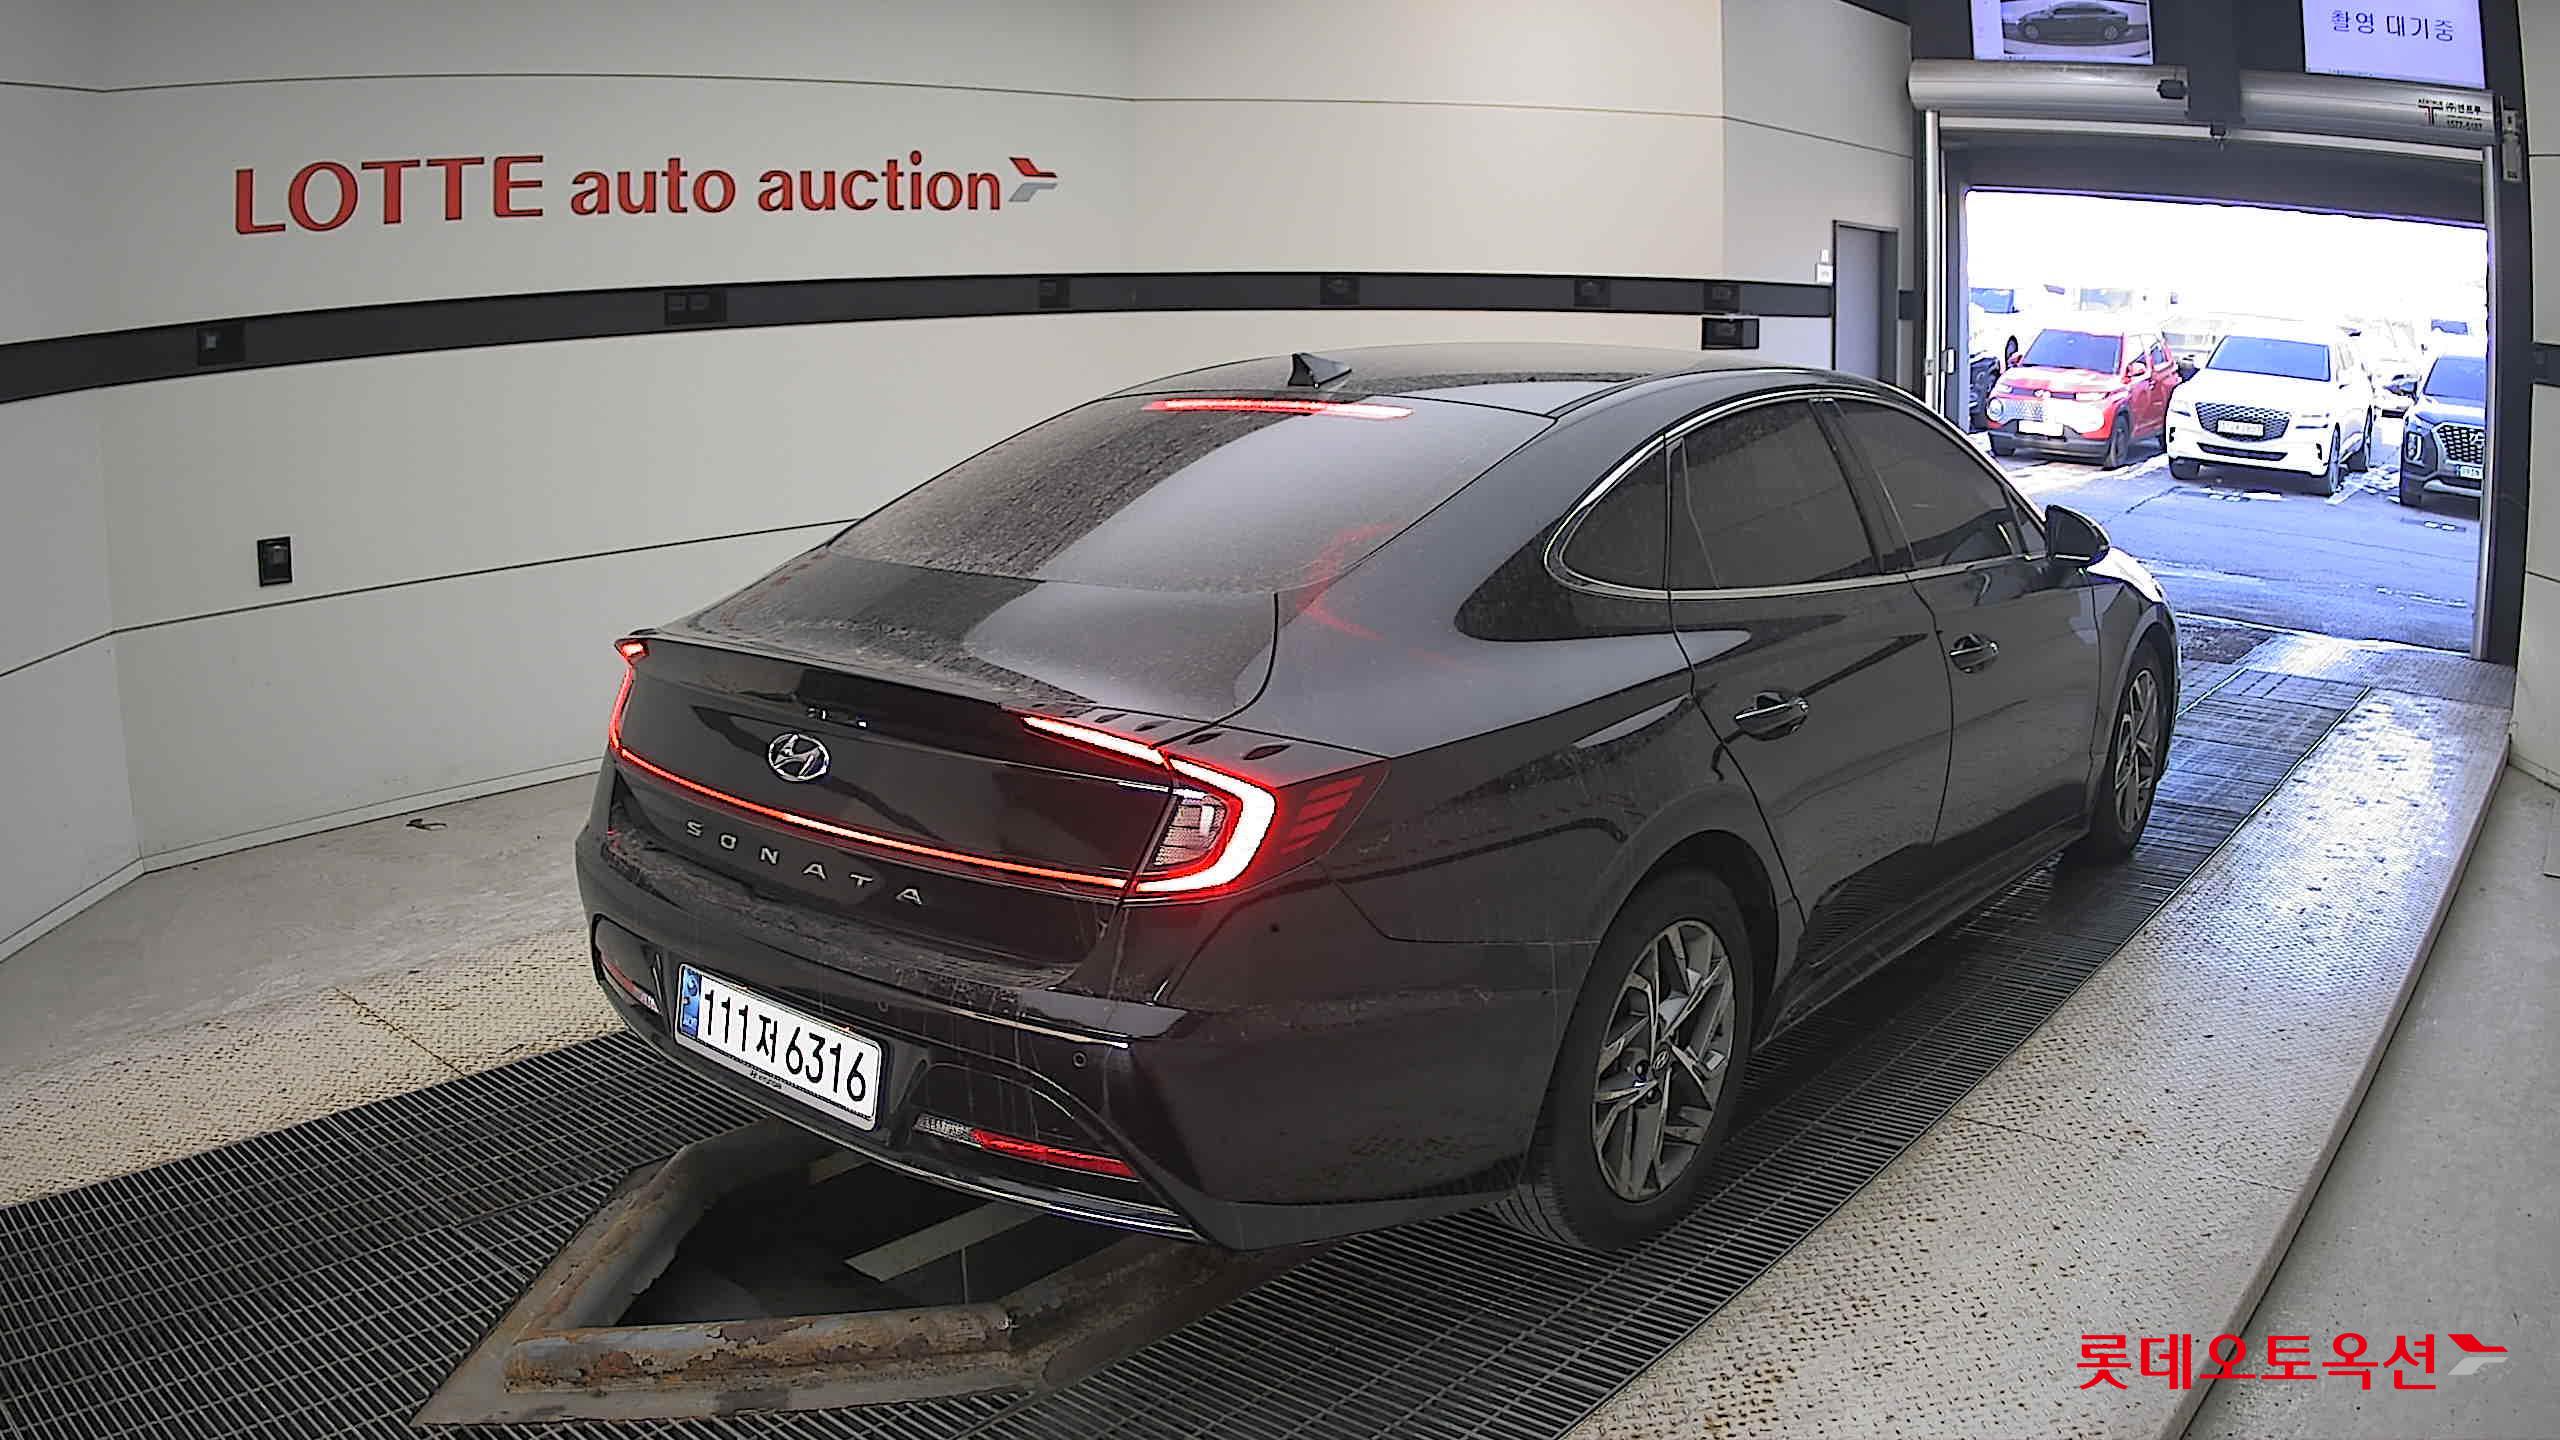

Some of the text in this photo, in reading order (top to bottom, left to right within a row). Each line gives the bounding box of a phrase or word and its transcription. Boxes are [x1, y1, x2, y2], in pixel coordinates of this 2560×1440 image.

[2331, 9, 2453, 42] 촬영 대기중
[235, 150, 1000, 235] LOTTE auto auction
[687, 820, 923, 905] SONATA
[704, 989, 867, 1102] 111저6316
